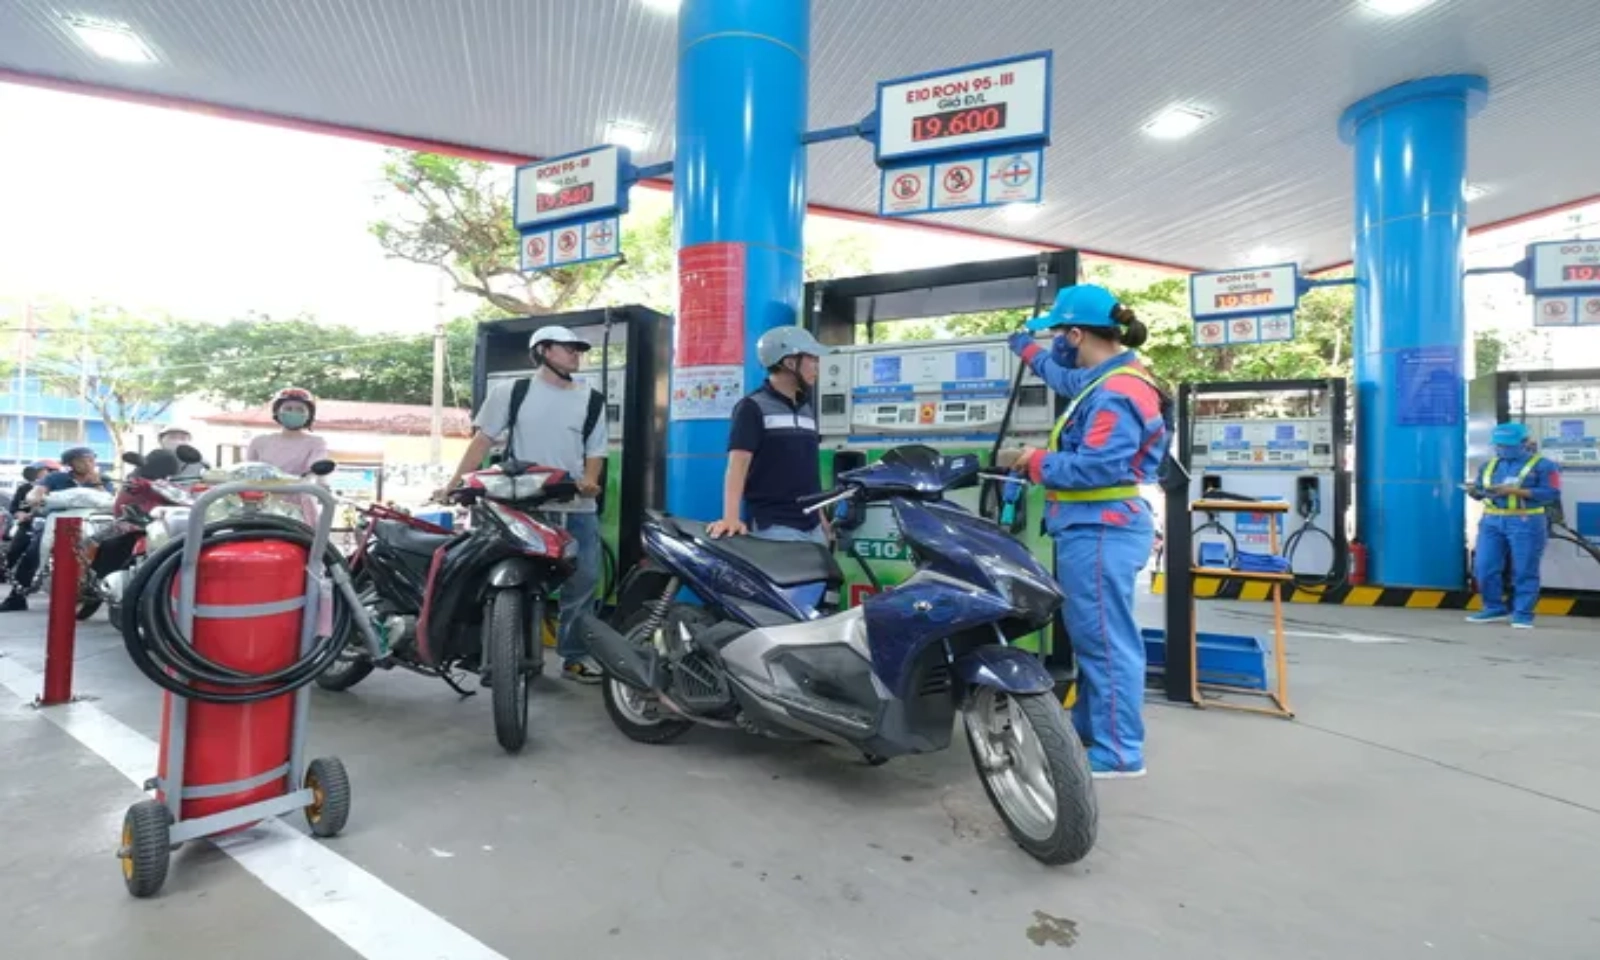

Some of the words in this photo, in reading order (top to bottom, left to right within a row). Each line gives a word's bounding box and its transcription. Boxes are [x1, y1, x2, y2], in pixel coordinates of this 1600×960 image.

[906, 89, 930, 103] E10
[932, 81, 969, 98] RON
[913, 107, 999, 141] 19.600
[854, 541, 897, 558] E10
